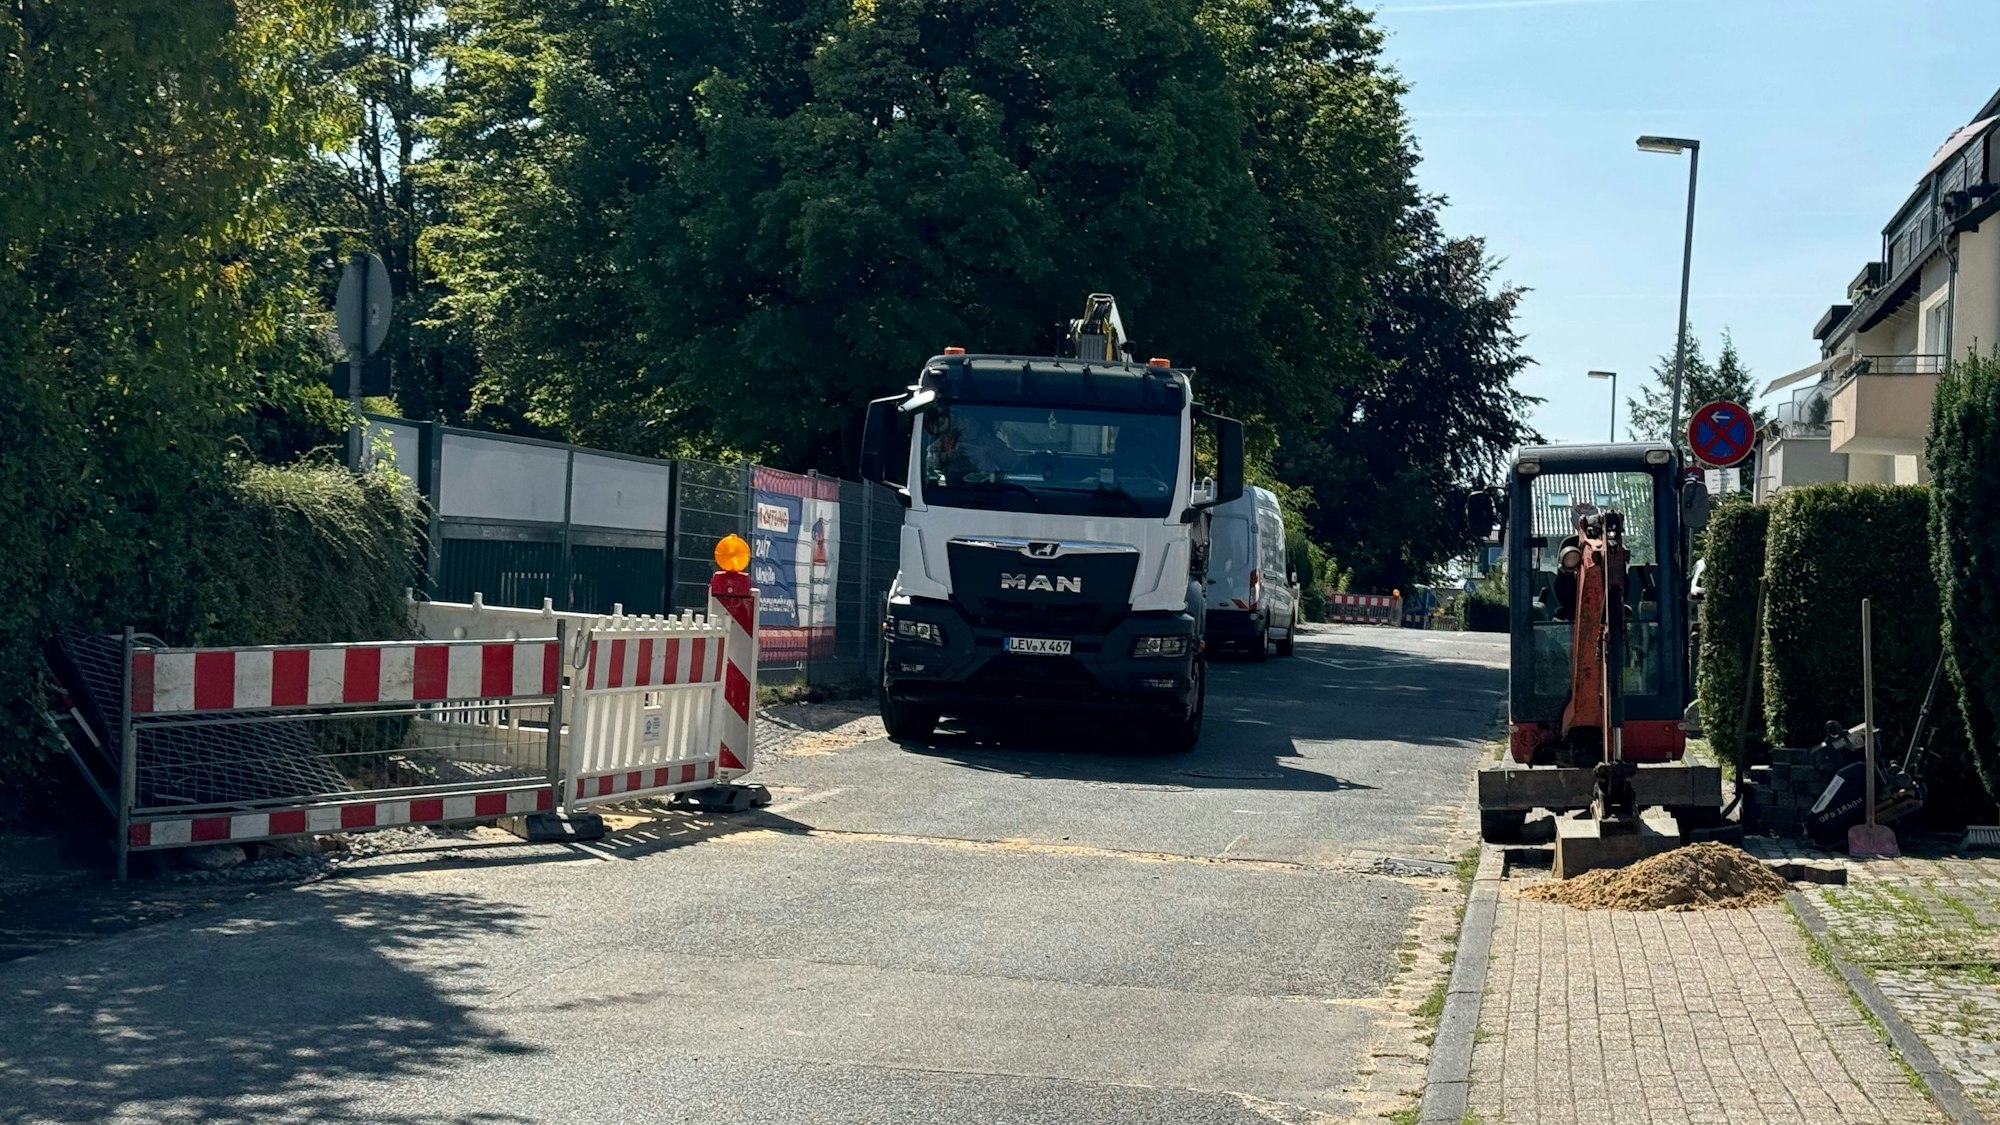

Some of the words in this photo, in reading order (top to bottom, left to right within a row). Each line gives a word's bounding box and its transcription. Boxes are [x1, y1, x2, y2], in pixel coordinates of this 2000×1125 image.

[1001, 572, 1081, 593] MAN
[1010, 639, 1033, 651] LEV
[1040, 640, 1046, 651] X
[1048, 641, 1069, 652] 467
